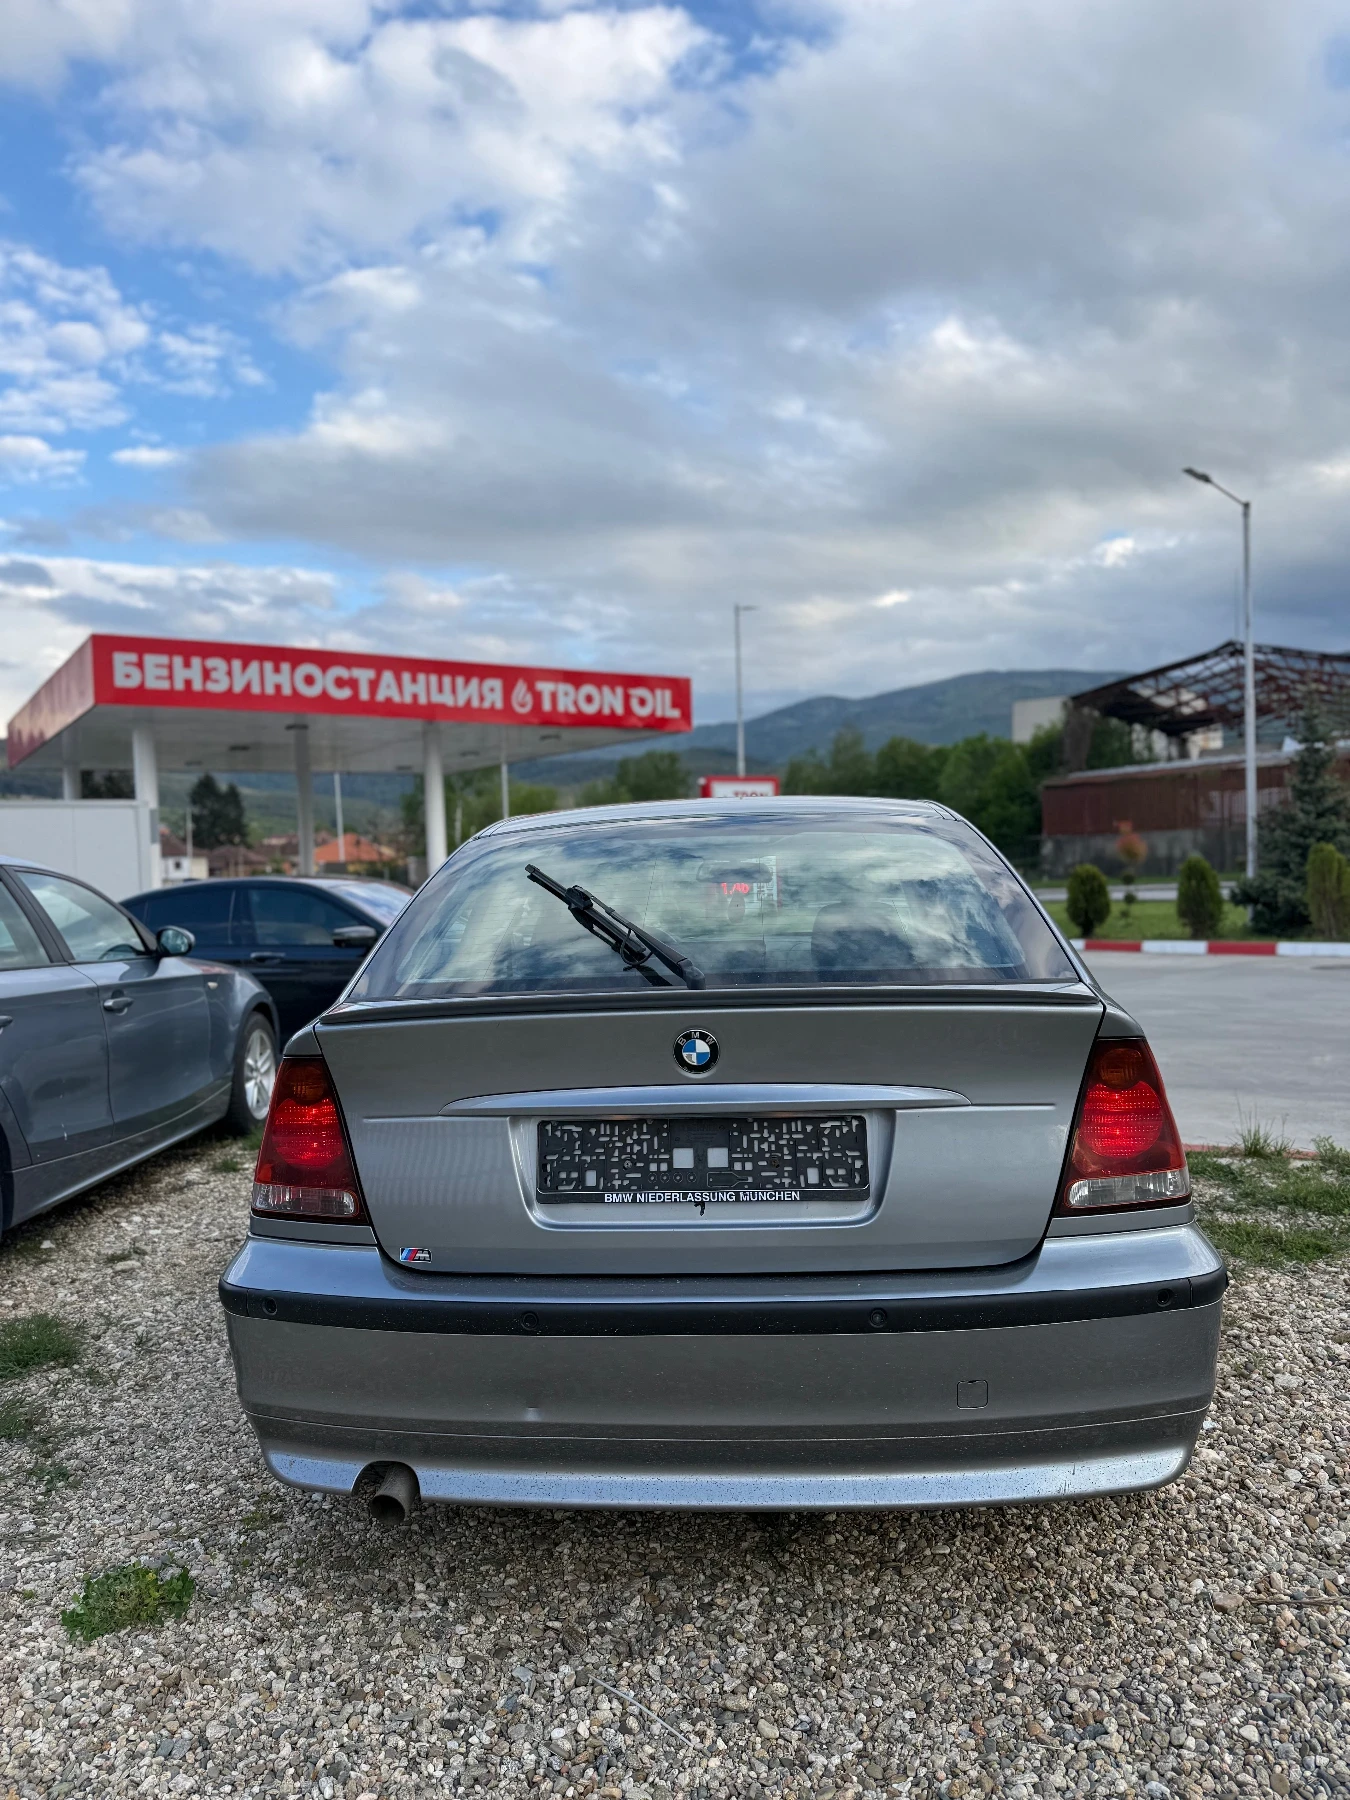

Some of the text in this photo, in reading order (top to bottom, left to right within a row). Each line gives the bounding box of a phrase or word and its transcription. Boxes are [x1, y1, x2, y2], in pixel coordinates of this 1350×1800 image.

[112, 651, 503, 711] БЕНЗИНОСТАНЦИЯ
[535, 685, 682, 719] TRON OIL
[677, 1031, 715, 1046] BMW
[604, 1192, 634, 1203] BMW
[636, 1191, 736, 1203] NIEDERLASSUNG
